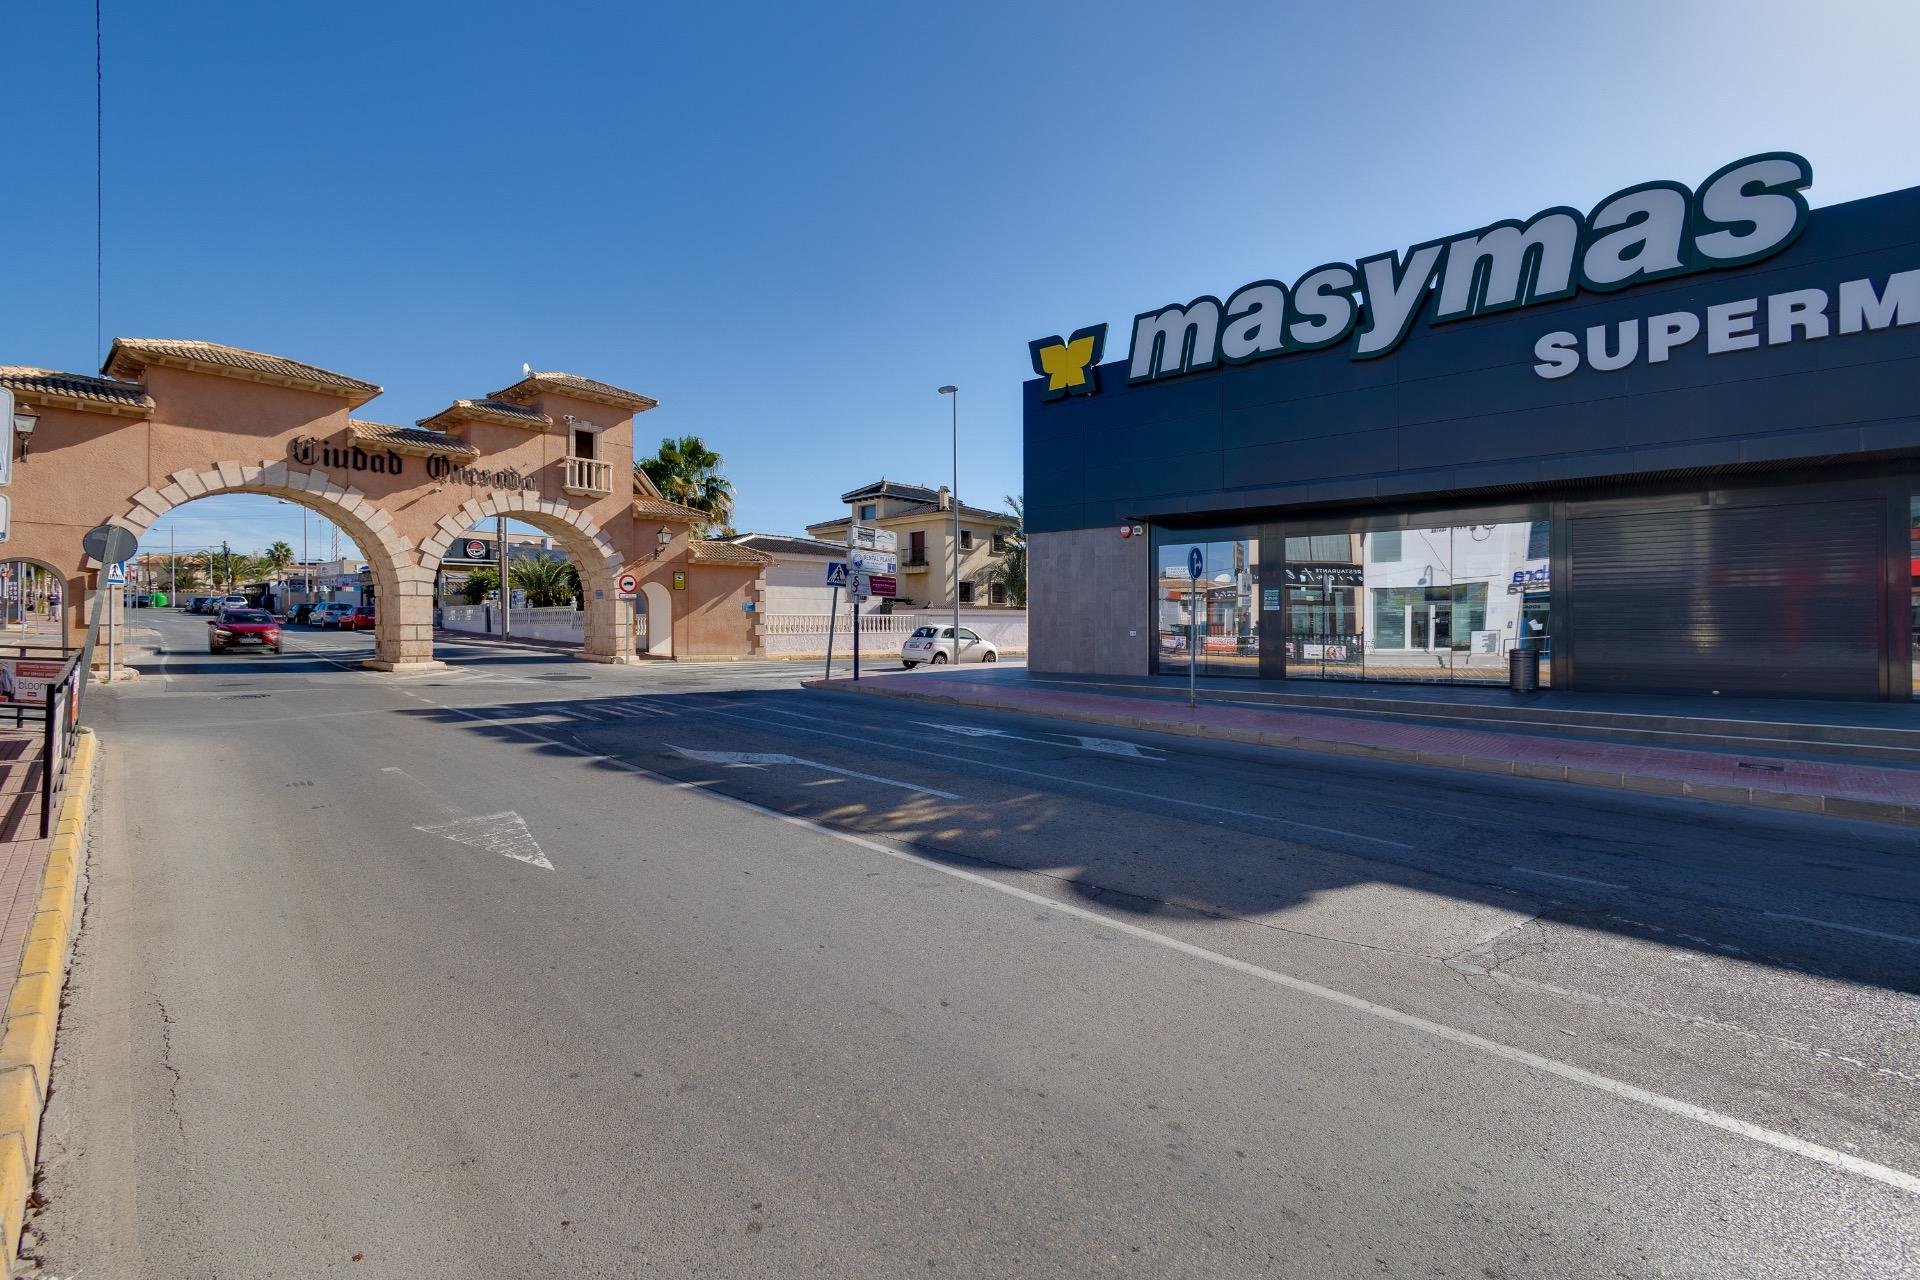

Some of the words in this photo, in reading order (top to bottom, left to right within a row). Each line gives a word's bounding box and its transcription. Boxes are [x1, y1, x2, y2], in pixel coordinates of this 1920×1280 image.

[1127, 151, 1813, 382] masymas
[1533, 269, 1920, 380] SUPERM
[292, 434, 403, 475] Ciudad
